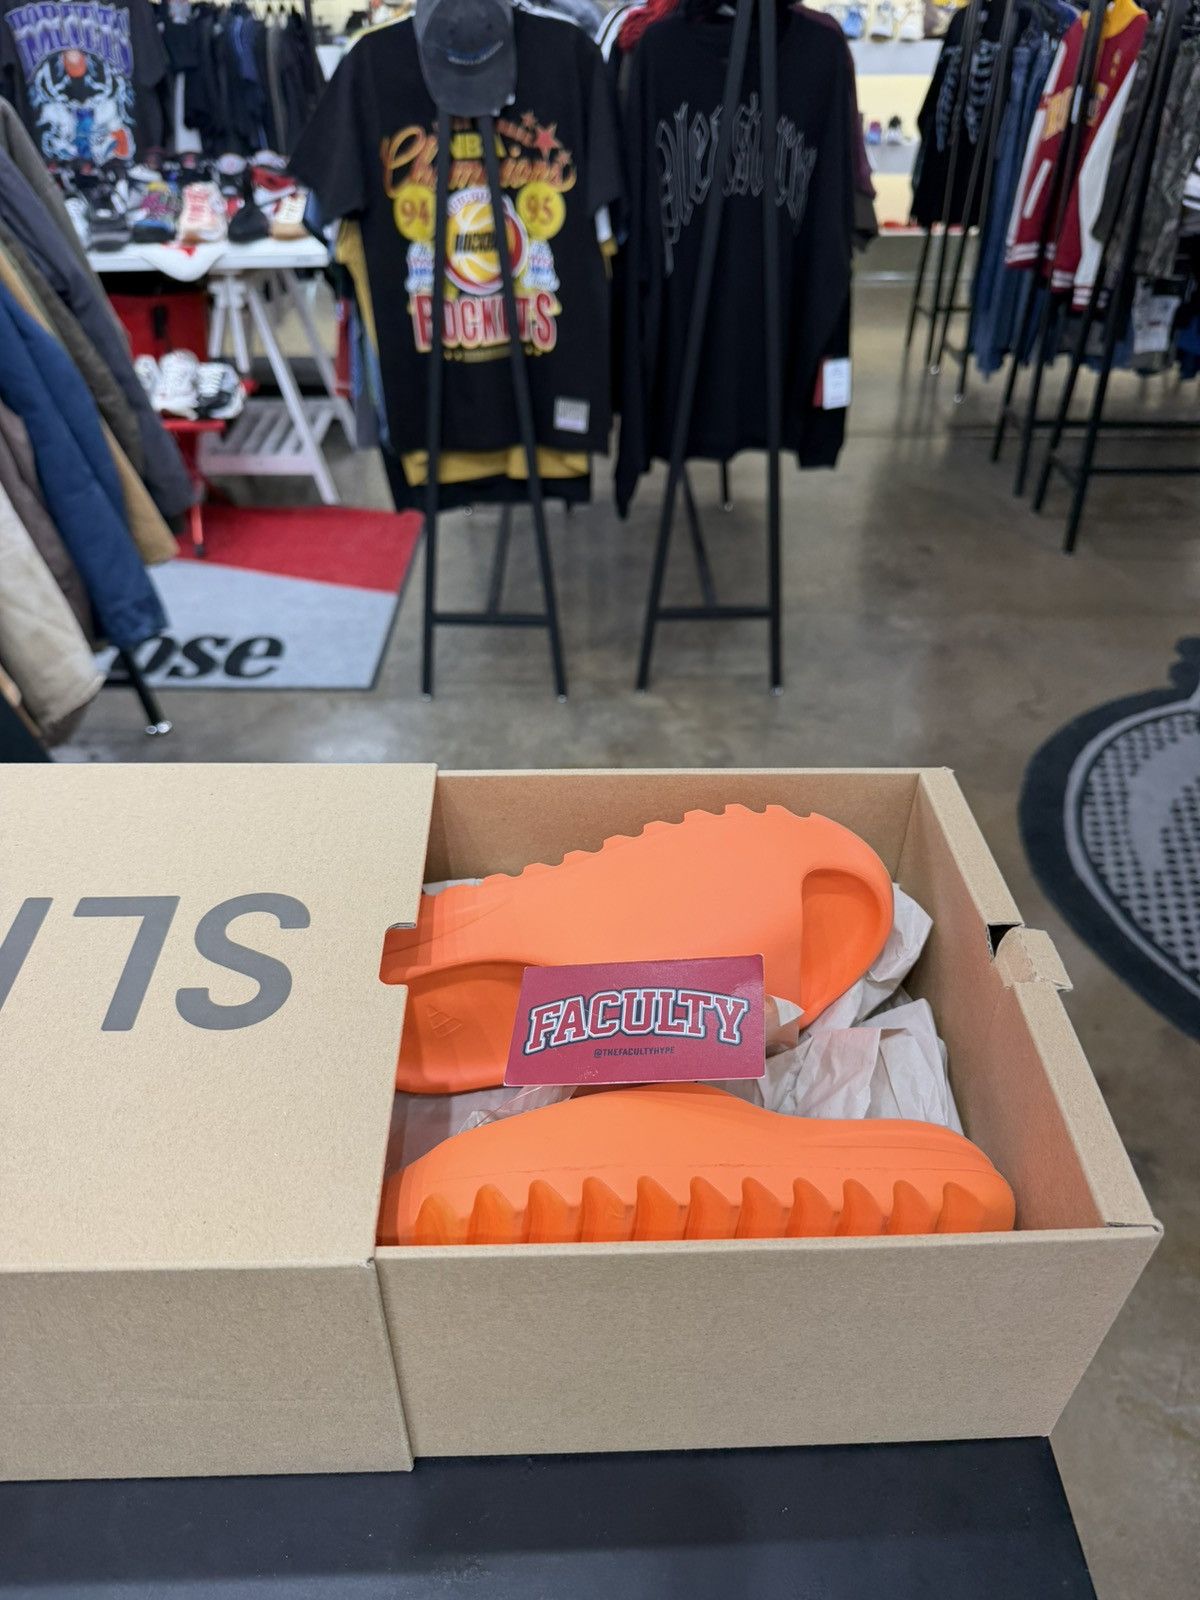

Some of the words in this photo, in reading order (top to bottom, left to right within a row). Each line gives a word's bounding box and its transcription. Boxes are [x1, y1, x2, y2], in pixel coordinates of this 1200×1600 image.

[526, 196, 555, 225] 95
[410, 288, 558, 353] ROCKTS
[522, 987, 751, 1056] FACULTY
[594, 1046, 675, 1058] @THEFACULTYHYPE
